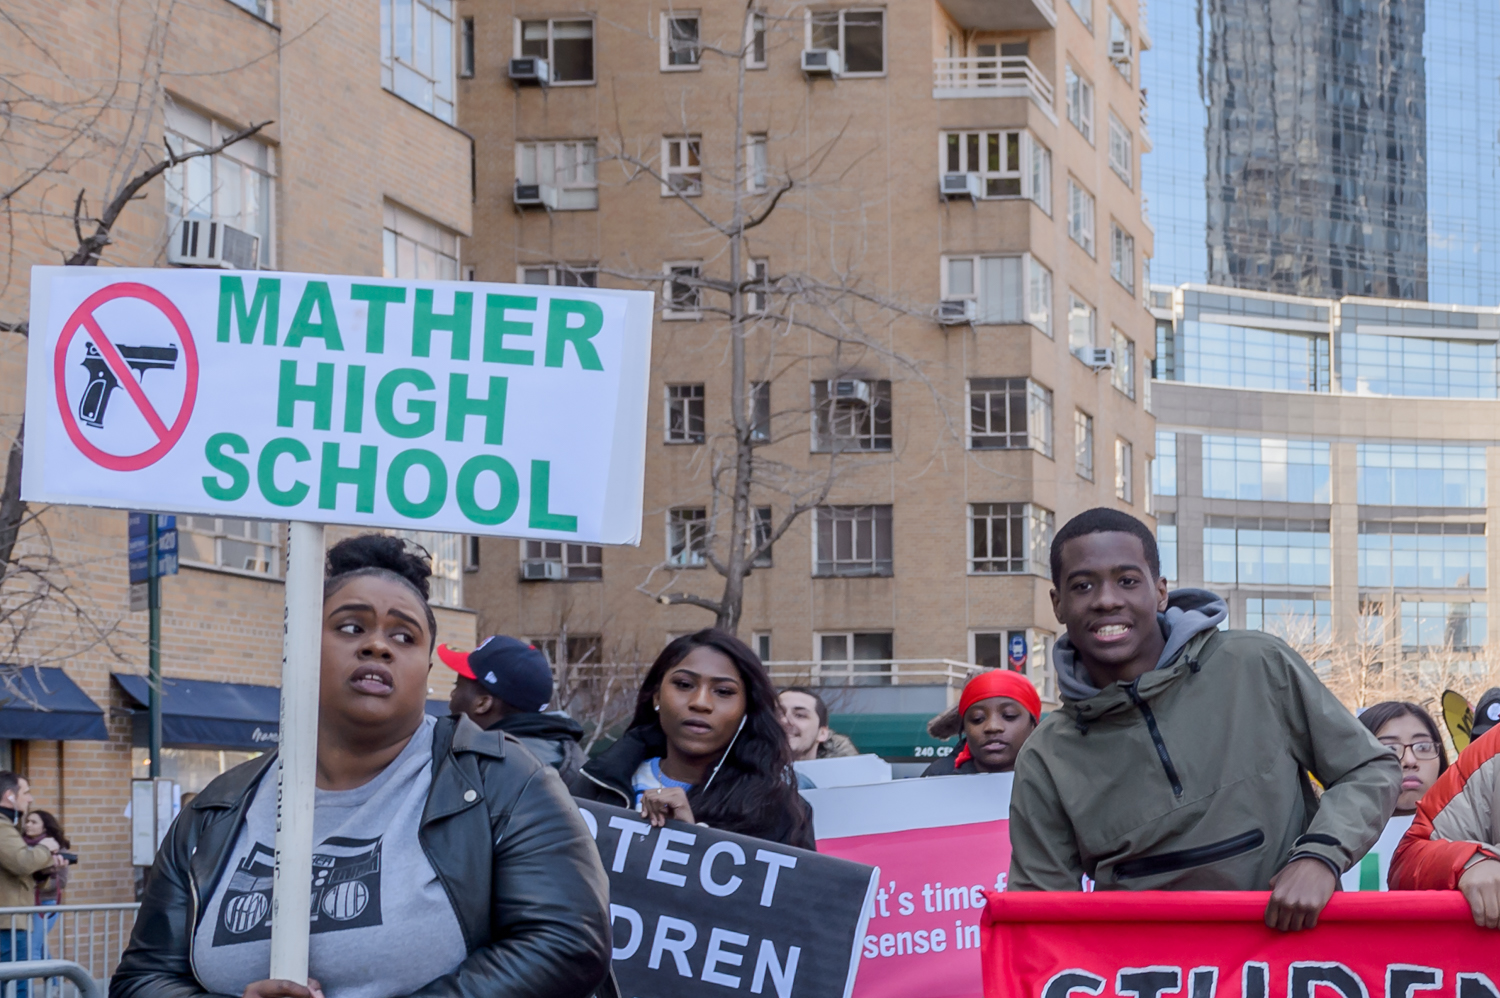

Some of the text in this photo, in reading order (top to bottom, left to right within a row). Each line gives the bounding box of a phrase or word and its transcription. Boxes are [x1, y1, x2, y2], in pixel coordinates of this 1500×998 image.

[216, 275, 604, 371] MATHER
[276, 359, 508, 446] HIGH
[201, 431, 578, 533] SCHOOL
[914, 746, 934, 757] 240
[579, 807, 798, 908] TECT
[921, 882, 988, 913] time
[863, 919, 981, 959] sense in
